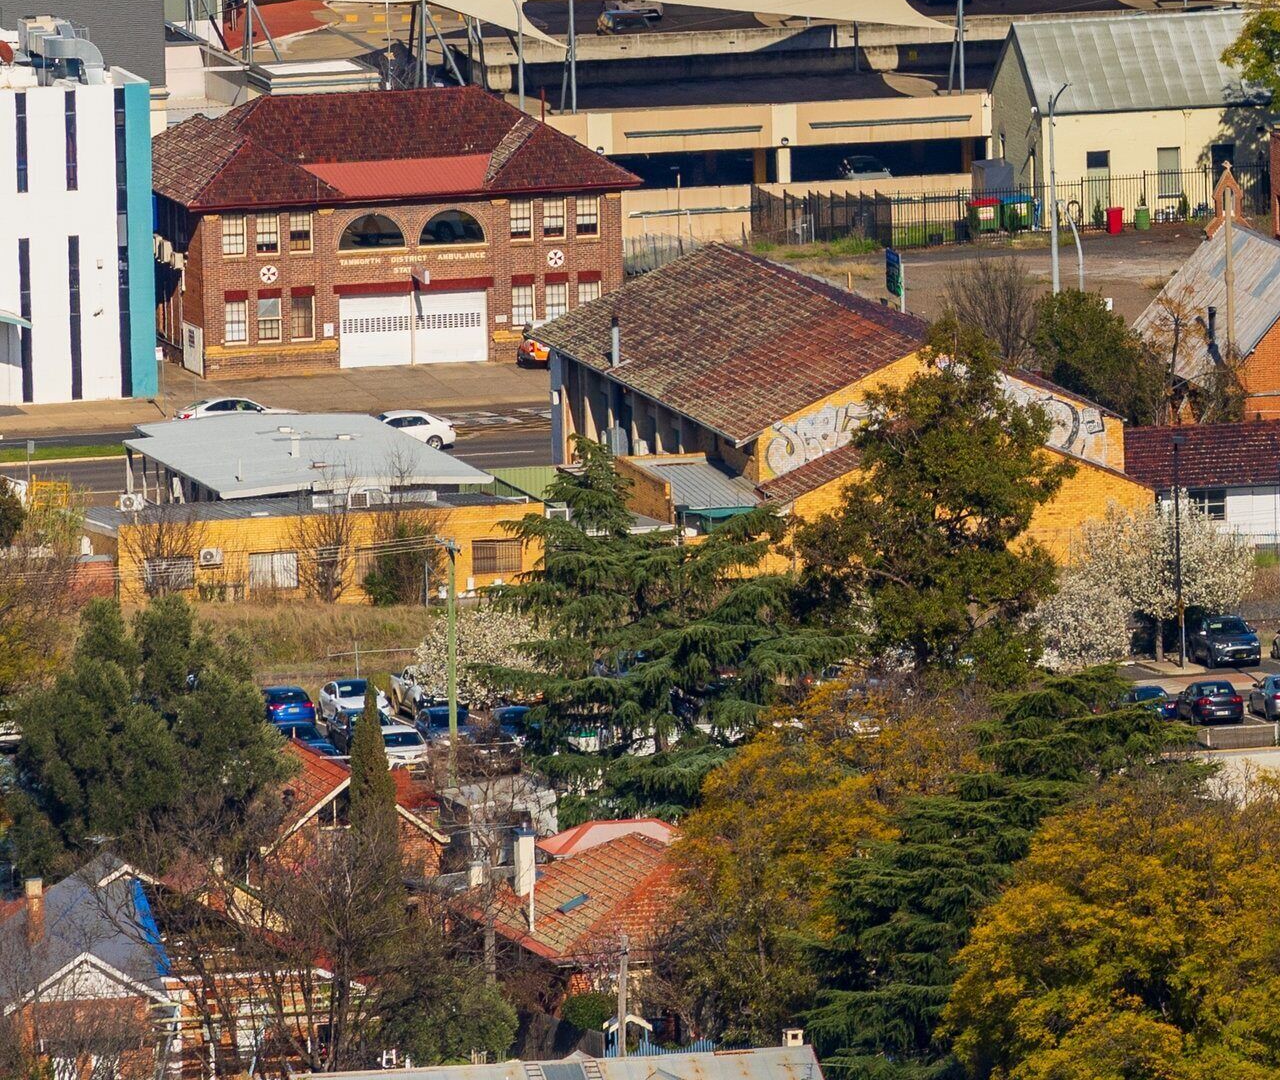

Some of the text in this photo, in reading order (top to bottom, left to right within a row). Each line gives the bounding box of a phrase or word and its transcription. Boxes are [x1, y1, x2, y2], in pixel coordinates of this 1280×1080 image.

[340, 251, 486, 266] TAMWORTH DISTRICT AMBULANCE
[393, 266, 412, 274] STAT
